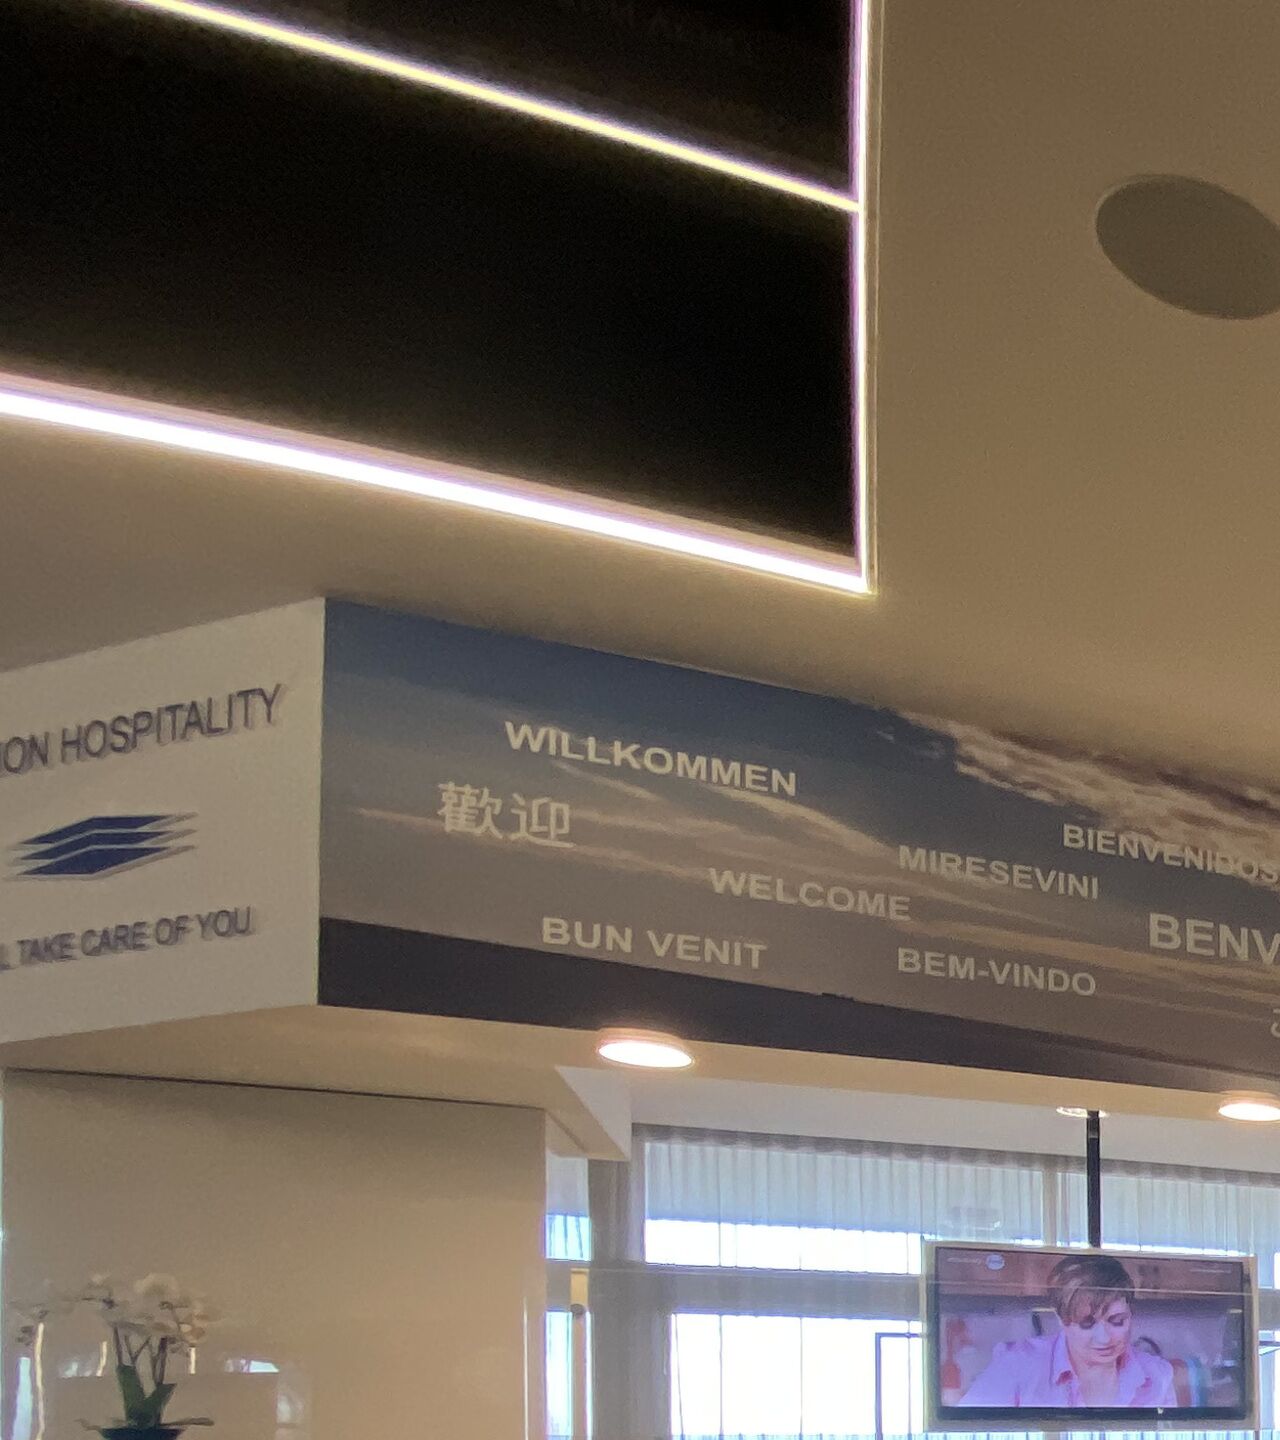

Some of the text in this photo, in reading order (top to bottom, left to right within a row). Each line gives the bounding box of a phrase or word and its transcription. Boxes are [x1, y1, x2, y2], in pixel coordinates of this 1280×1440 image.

[0, 684, 283, 773] ON HOSPITALITY
[504, 720, 797, 797] WILLKOMMEN
[437, 780, 576, 849] 歡迎
[899, 845, 1099, 900] MIRESEVINI
[1063, 823, 1280, 885] BIENVENIDOS
[709, 867, 912, 921] WELCOME
[18, 932, 76, 967] TAKE
[81, 921, 149, 957] CARE
[155, 915, 189, 946] OF
[196, 905, 253, 939] YOU
[541, 915, 767, 971] BUN VENIT
[898, 946, 1096, 998] BEM-VINDO
